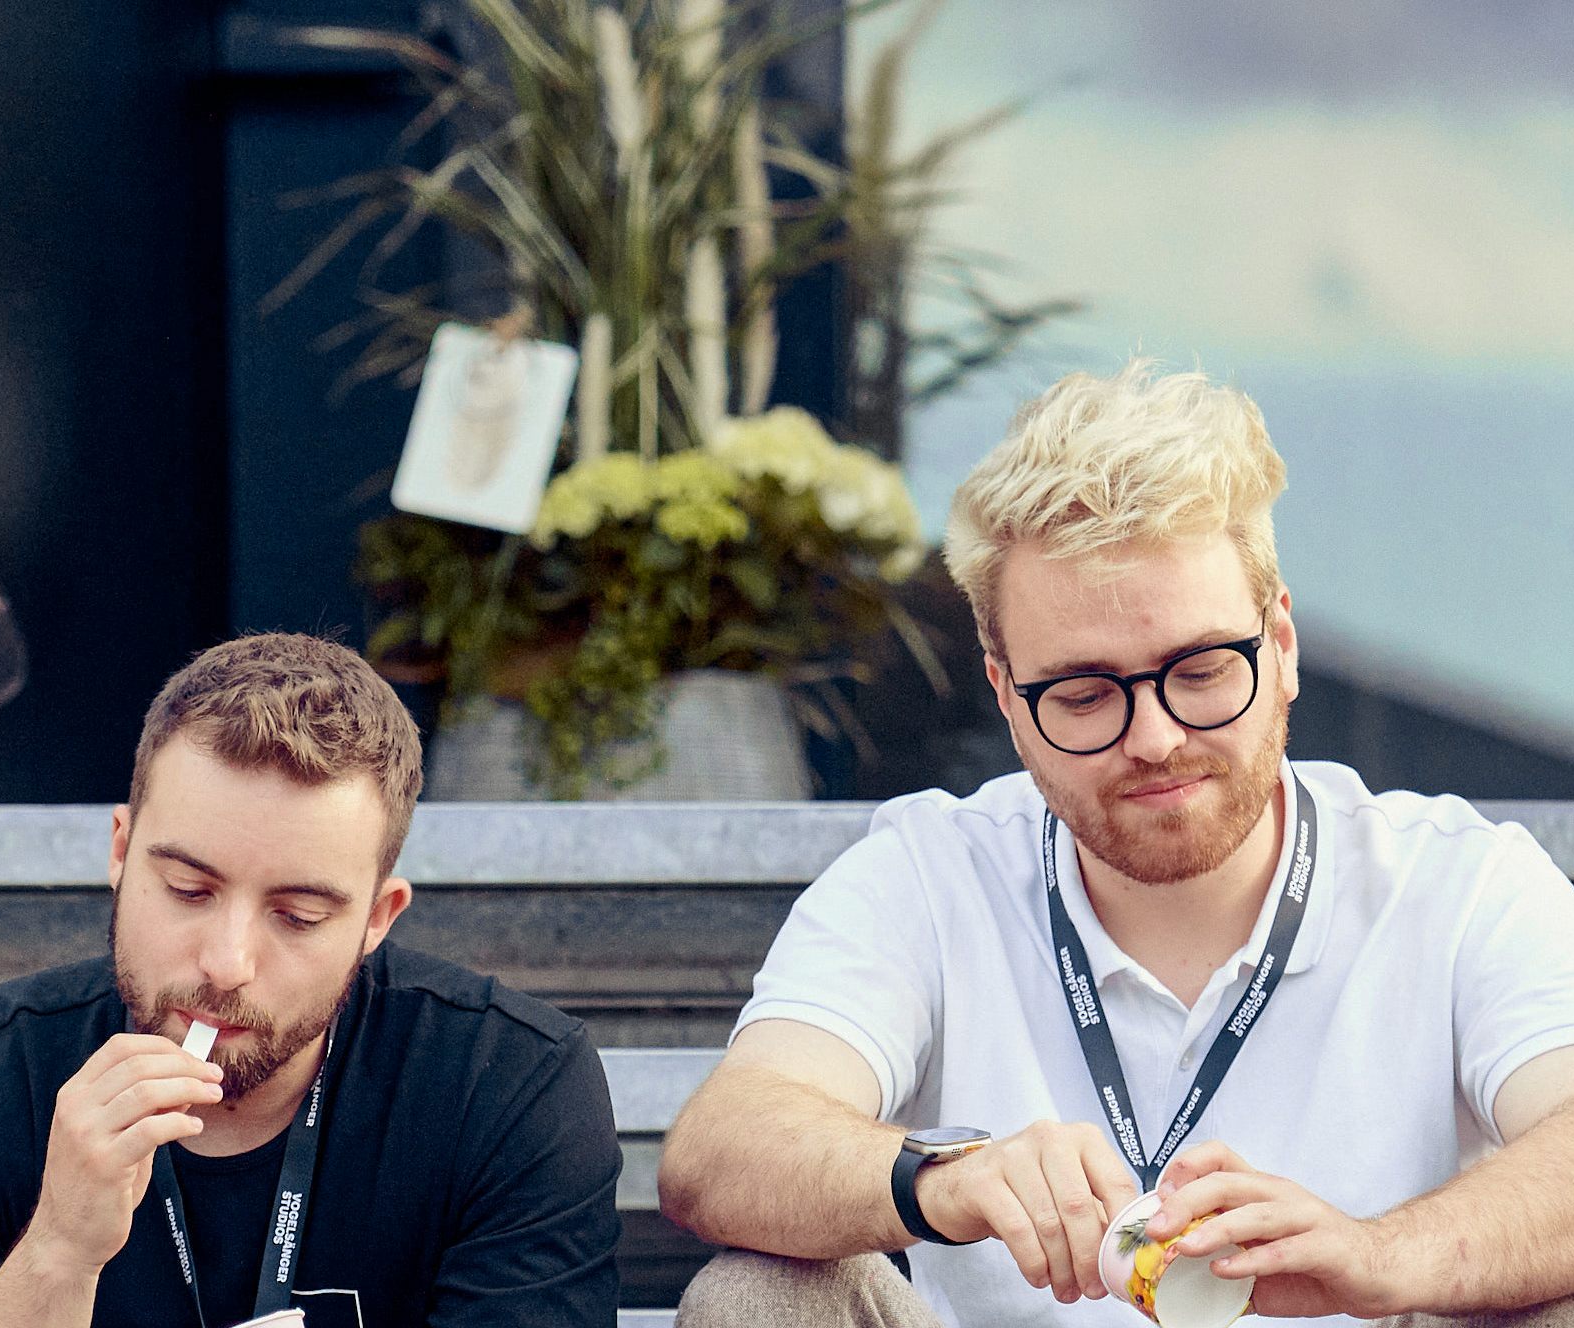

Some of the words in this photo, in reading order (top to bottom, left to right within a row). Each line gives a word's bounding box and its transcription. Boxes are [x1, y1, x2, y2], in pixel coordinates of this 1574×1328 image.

[1287, 820, 1309, 898] VOGELSÄNGER
[1295, 857, 1312, 903] STUDIOS
[1060, 946, 1090, 1028] VOGELSÄNGER
[1077, 974, 1100, 1025] STUDIOS
[1227, 953, 1275, 1032] VOGELSÄNGER
[1235, 991, 1267, 1037] STUDIOS
[1103, 1085, 1138, 1166] VOGELSÄNGER
[1123, 1117, 1145, 1167] STUDIOS
[1154, 1087, 1202, 1165] VOGELSÄNGER
[1157, 1123, 1190, 1167] STUDIOS
[273, 1191, 292, 1245] STUDIOS
[276, 1193, 302, 1283] VOGELSÄNGER
